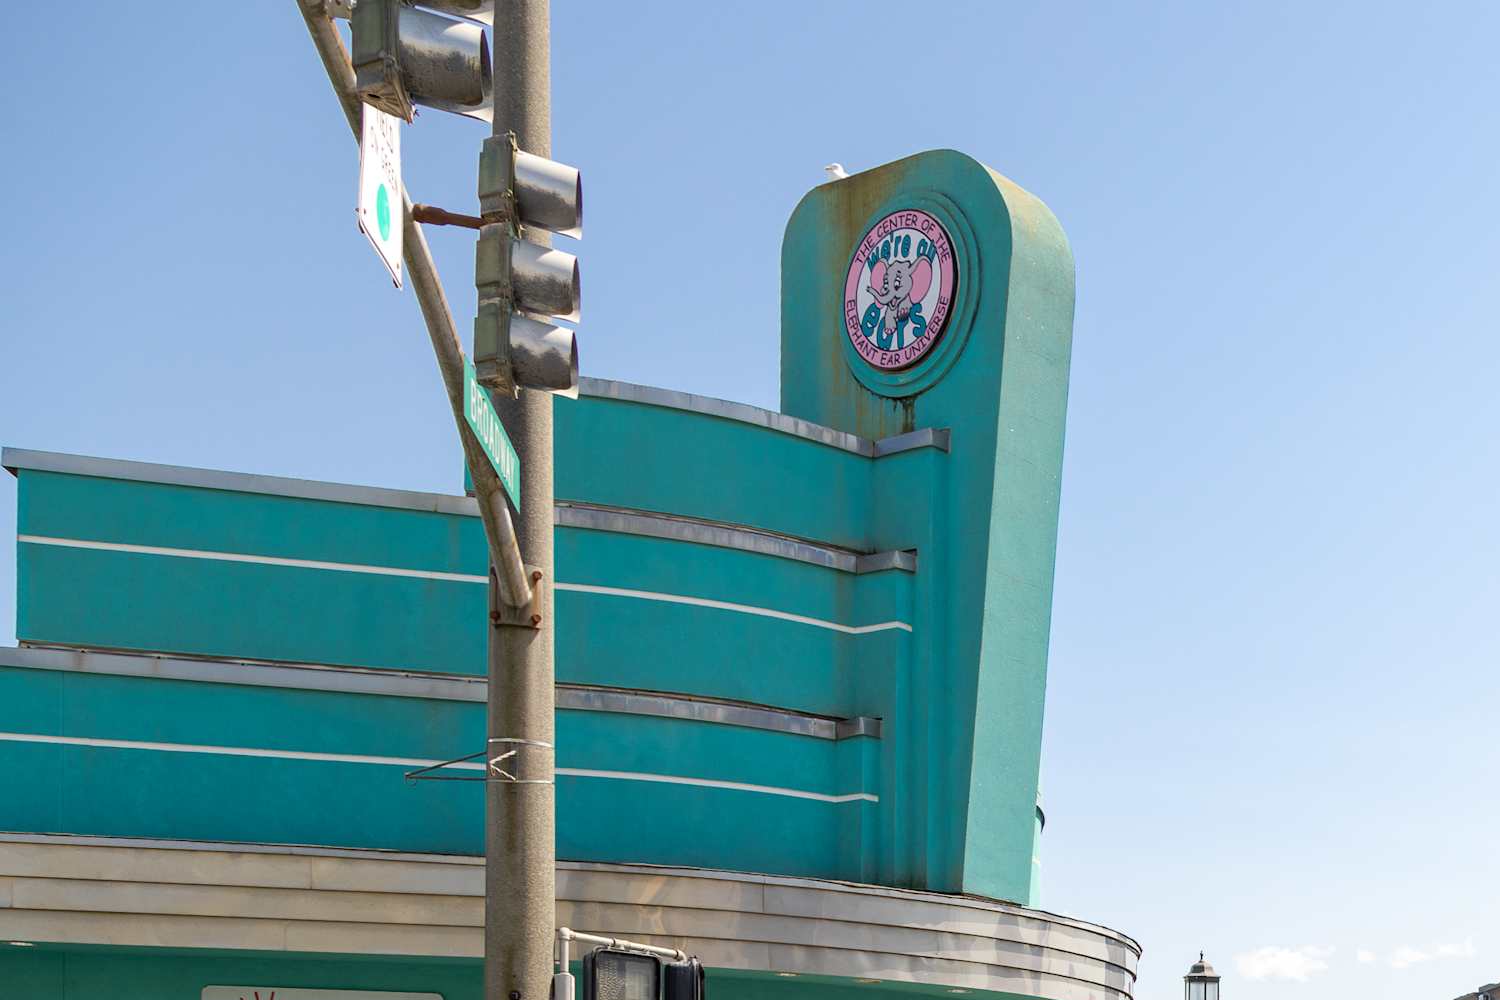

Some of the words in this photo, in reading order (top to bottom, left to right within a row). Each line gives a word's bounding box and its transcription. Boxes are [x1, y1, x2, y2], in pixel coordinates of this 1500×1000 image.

[855, 236, 874, 263] THE
[877, 213, 918, 236] CENTER
[921, 219, 936, 235] OF
[936, 233, 951, 264] THE
[846, 300, 879, 360] ELEPHANT
[880, 353, 901, 366] EAR
[904, 295, 949, 360] UNIVERSE
[470, 378, 514, 493] BROADWAY
